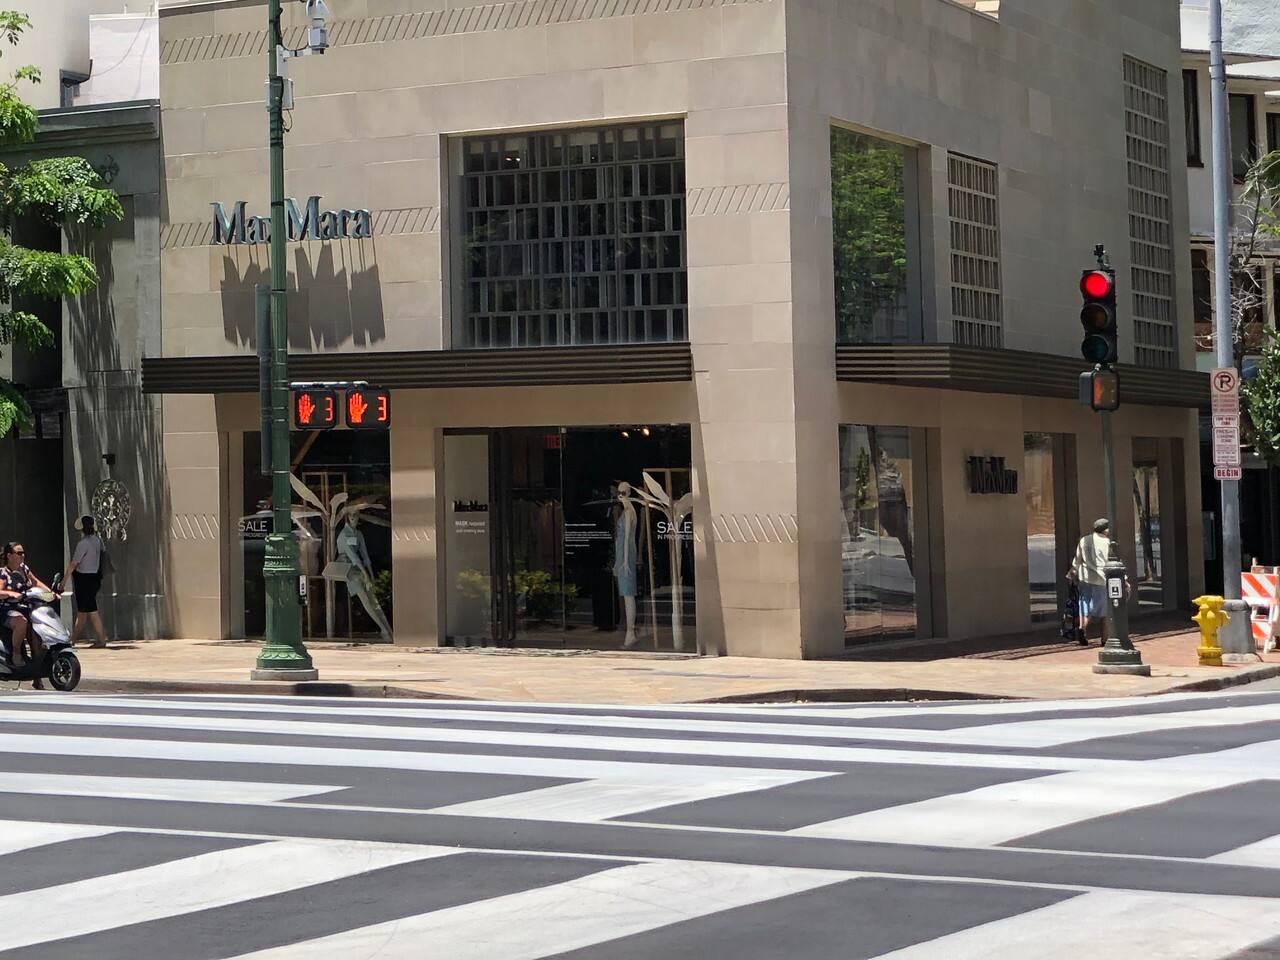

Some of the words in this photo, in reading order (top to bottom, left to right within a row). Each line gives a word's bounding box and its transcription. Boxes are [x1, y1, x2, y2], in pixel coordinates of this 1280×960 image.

[210, 195, 373, 246] MaMara
[325, 397, 333, 421] 3
[377, 396, 387, 421] 3
[1217, 469, 1239, 477] BEGIN
[238, 520, 268, 532] SALE
[657, 521, 693, 534] SALE
